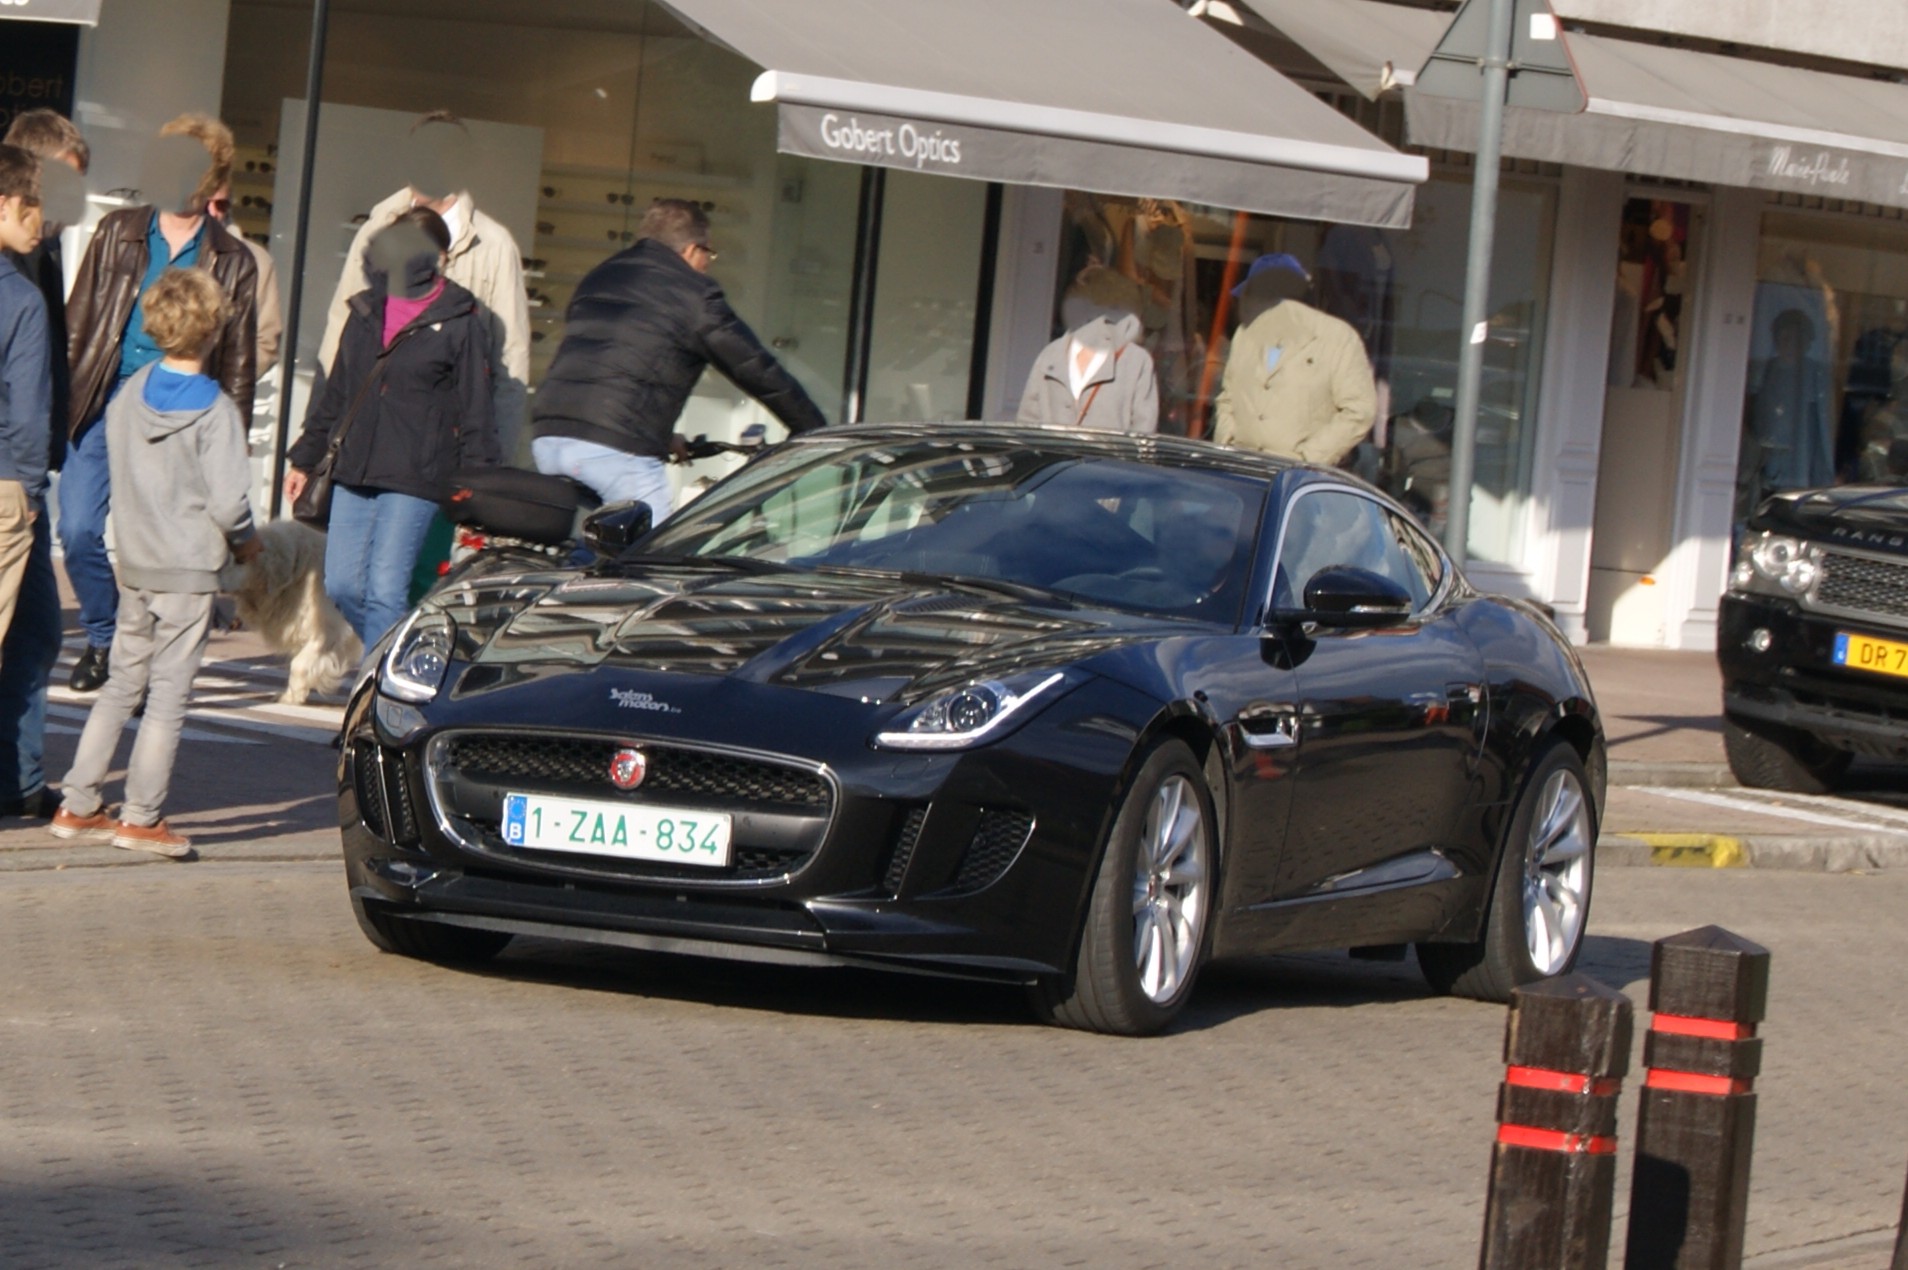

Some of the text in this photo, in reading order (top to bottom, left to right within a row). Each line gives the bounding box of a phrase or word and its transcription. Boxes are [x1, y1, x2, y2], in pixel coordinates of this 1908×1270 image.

[821, 113, 961, 169] Gobert Optics
[1860, 643, 1888, 667] DR
[510, 822, 523, 840] B
[532, 807, 720, 855] 1-ZAA-834
